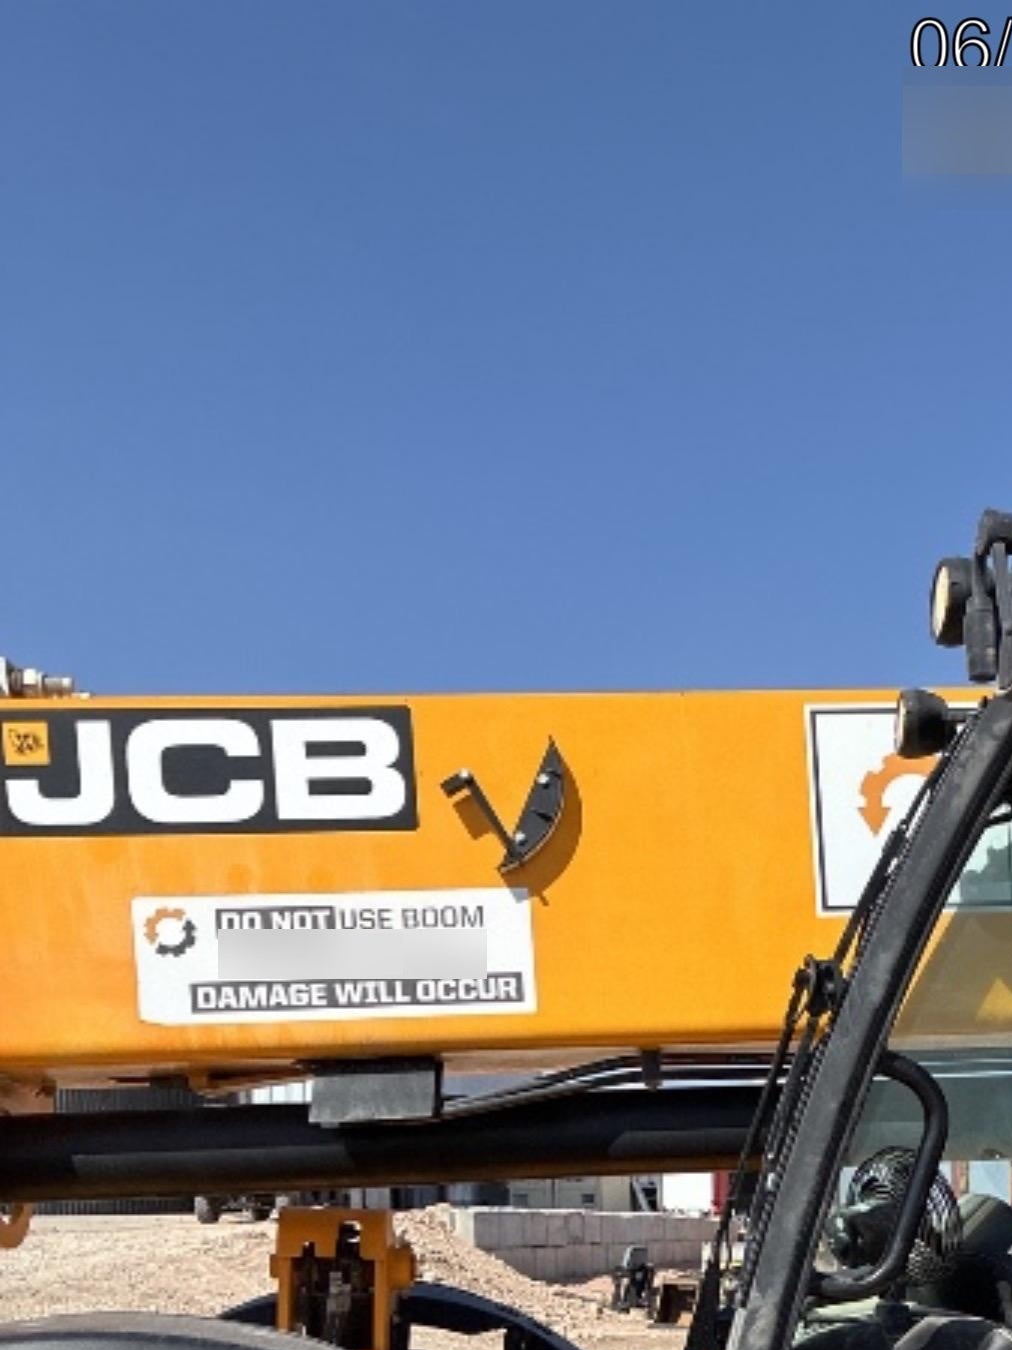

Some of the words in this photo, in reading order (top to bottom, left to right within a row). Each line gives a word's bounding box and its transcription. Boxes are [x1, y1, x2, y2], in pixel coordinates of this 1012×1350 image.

[5, 719, 406, 826] JCB
[220, 910, 262, 930] DO
[270, 909, 331, 930] NOT
[339, 908, 393, 930] USE
[401, 905, 485, 929] BOOM
[196, 983, 328, 1010] DAMAGE
[333, 979, 412, 1004] WILL
[415, 976, 519, 1001] OCCUR
